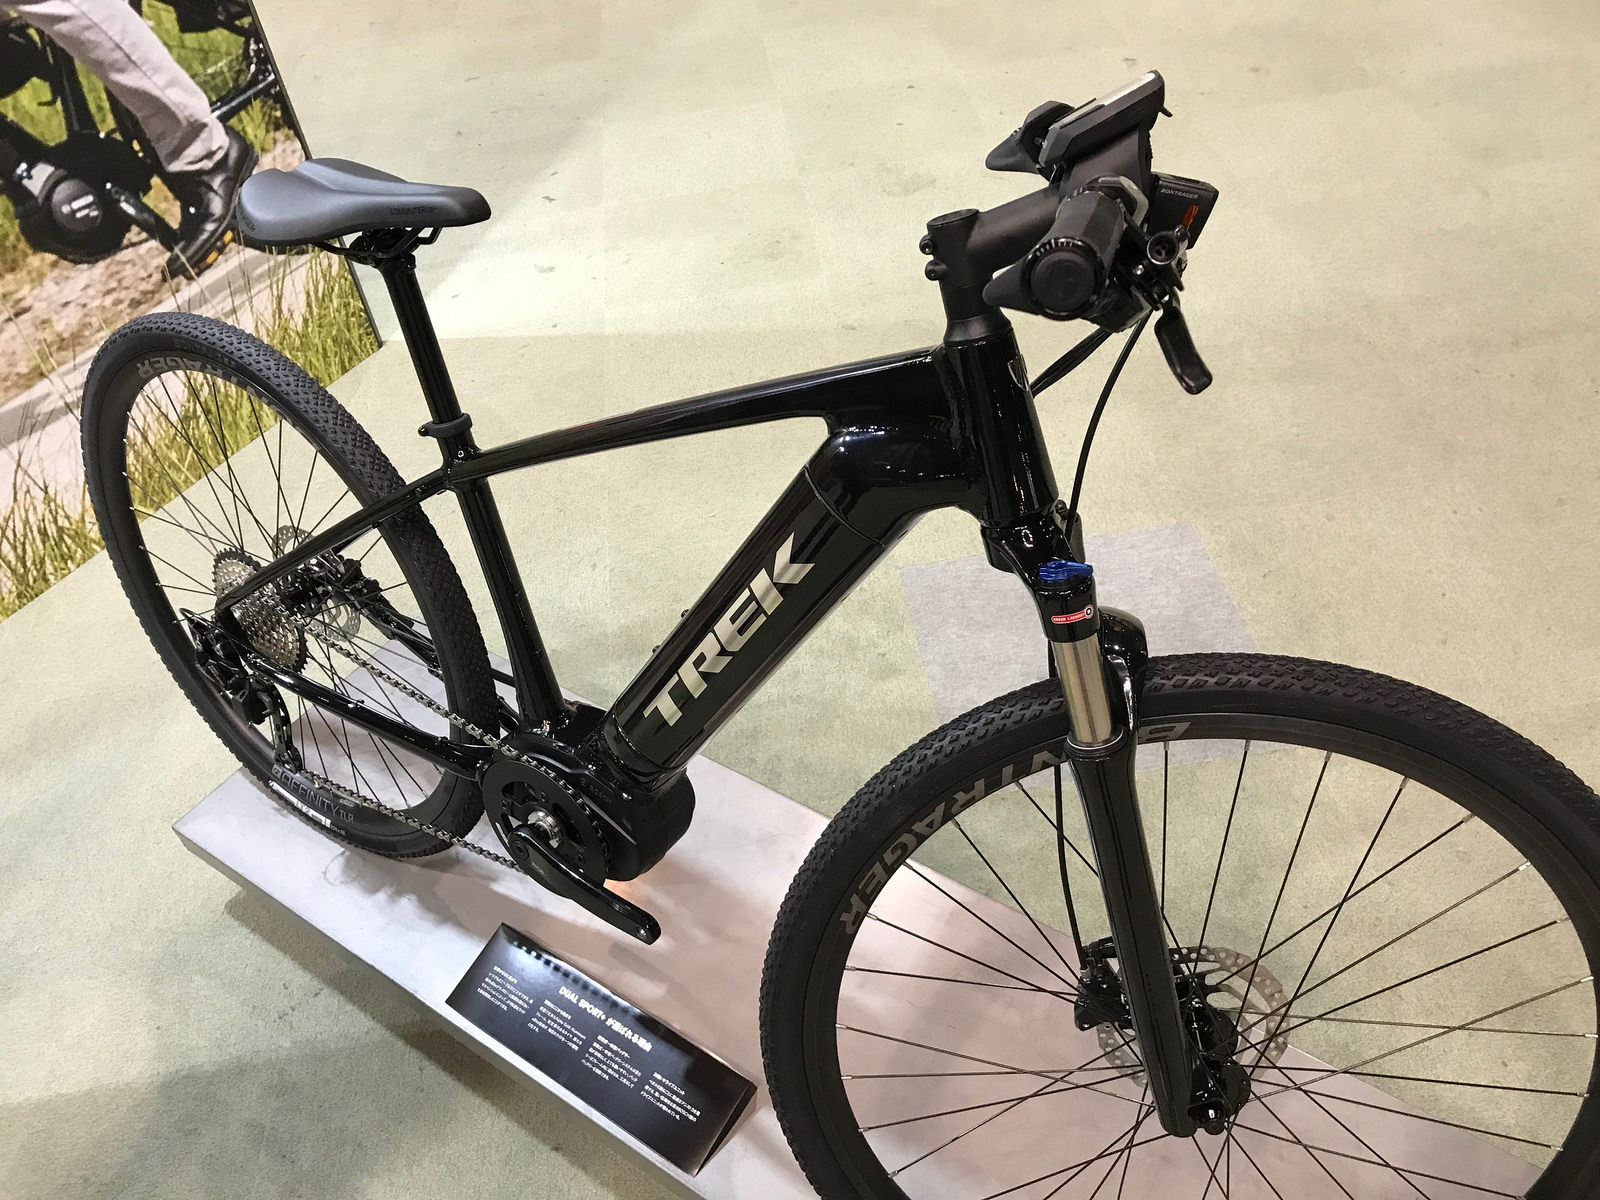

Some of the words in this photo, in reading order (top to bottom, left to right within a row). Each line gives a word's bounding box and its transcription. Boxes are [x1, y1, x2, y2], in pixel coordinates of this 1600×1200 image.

[1160, 188, 1199, 199] BONTRAGER
[643, 532, 816, 727] TREK
[281, 773, 339, 816] AFFINITY
[340, 810, 355, 824] TLR
[557, 985, 579, 1003] DUAL
